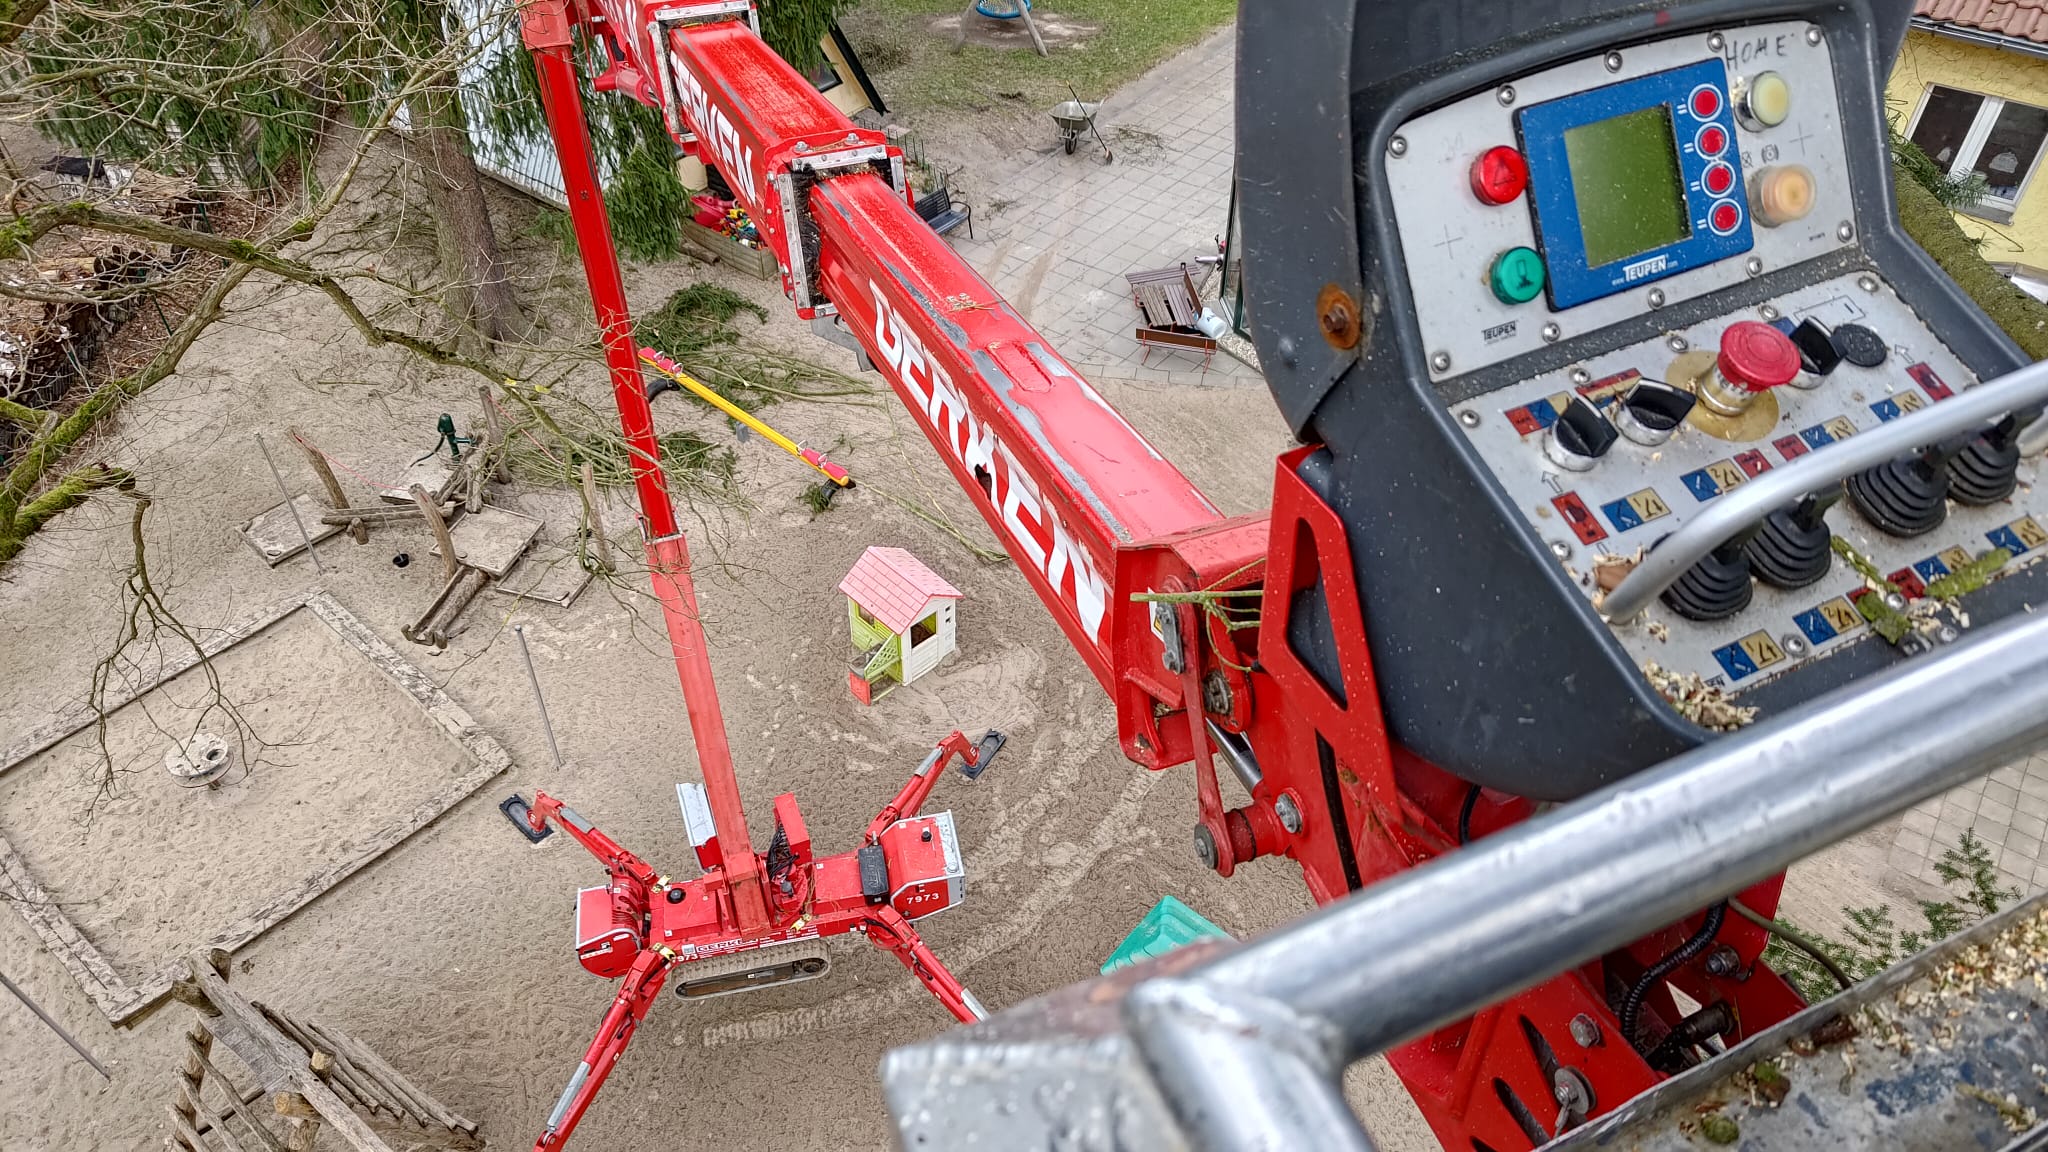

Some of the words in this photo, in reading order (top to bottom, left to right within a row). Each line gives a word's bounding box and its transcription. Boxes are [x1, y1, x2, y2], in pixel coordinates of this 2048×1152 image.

[1724, 35, 1788, 70] HOME
[1481, 320, 1517, 341] TEUPEN
[869, 277, 1114, 646] GERKEN
[906, 892, 940, 905] 7973
